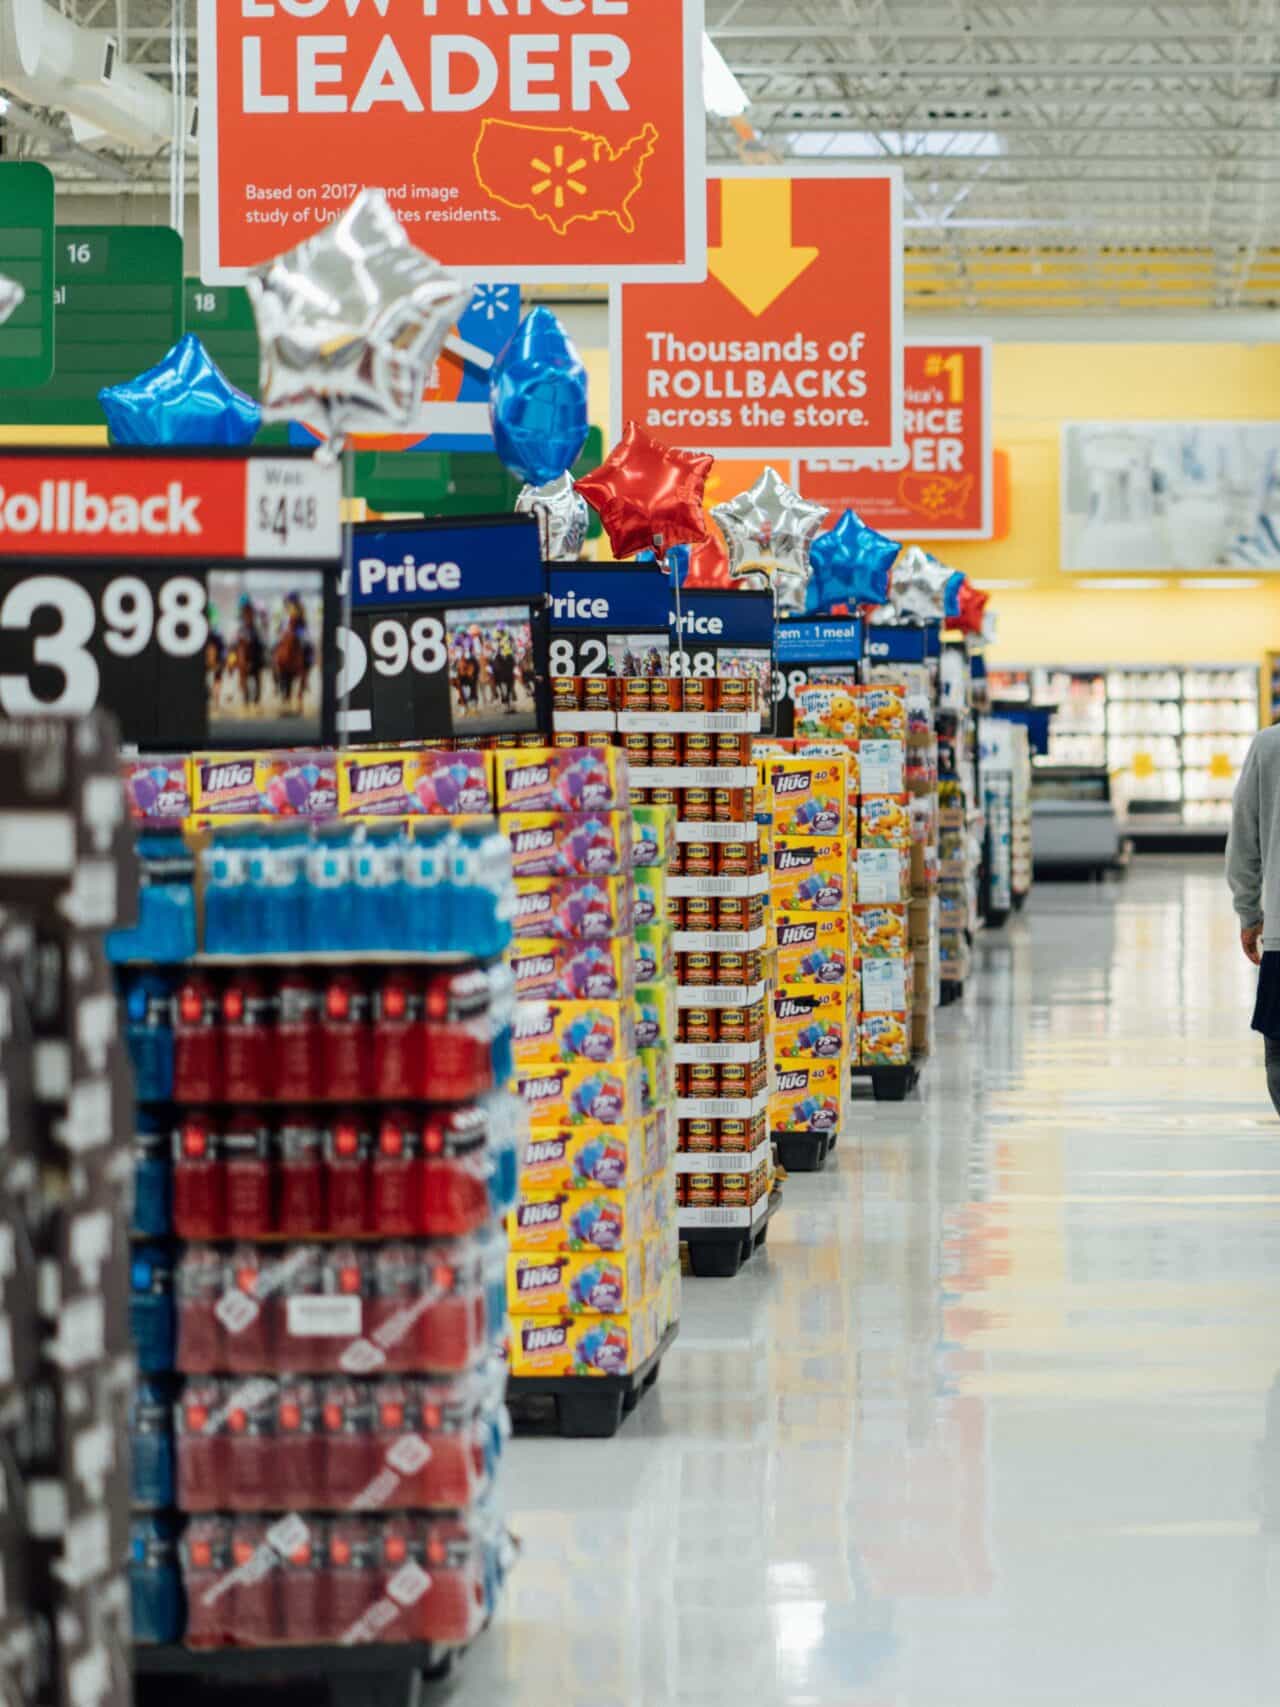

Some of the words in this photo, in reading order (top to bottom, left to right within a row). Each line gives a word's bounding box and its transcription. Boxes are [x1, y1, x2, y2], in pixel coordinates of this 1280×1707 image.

[241, 33, 631, 113] LEADER
[245, 183, 292, 200] Based
[297, 187, 317, 200] on
[321, 184, 357, 200] 2017
[411, 184, 459, 202] image
[245, 207, 288, 226] study
[292, 206, 311, 223] of
[425, 207, 501, 223] residents.
[66, 243, 91, 263] 16
[193, 292, 216, 312] 18
[645, 331, 819, 362] Thousands
[827, 331, 866, 362] of
[646, 369, 868, 399] ROLLBACKS
[923, 352, 964, 403] #1
[904, 384, 944, 404] ica's
[646, 406, 732, 427] across
[739, 401, 786, 427] the
[793, 403, 869, 427] store.
[0, 479, 203, 534] ollback
[358, 554, 462, 594] Price
[549, 638, 608, 677] 82
